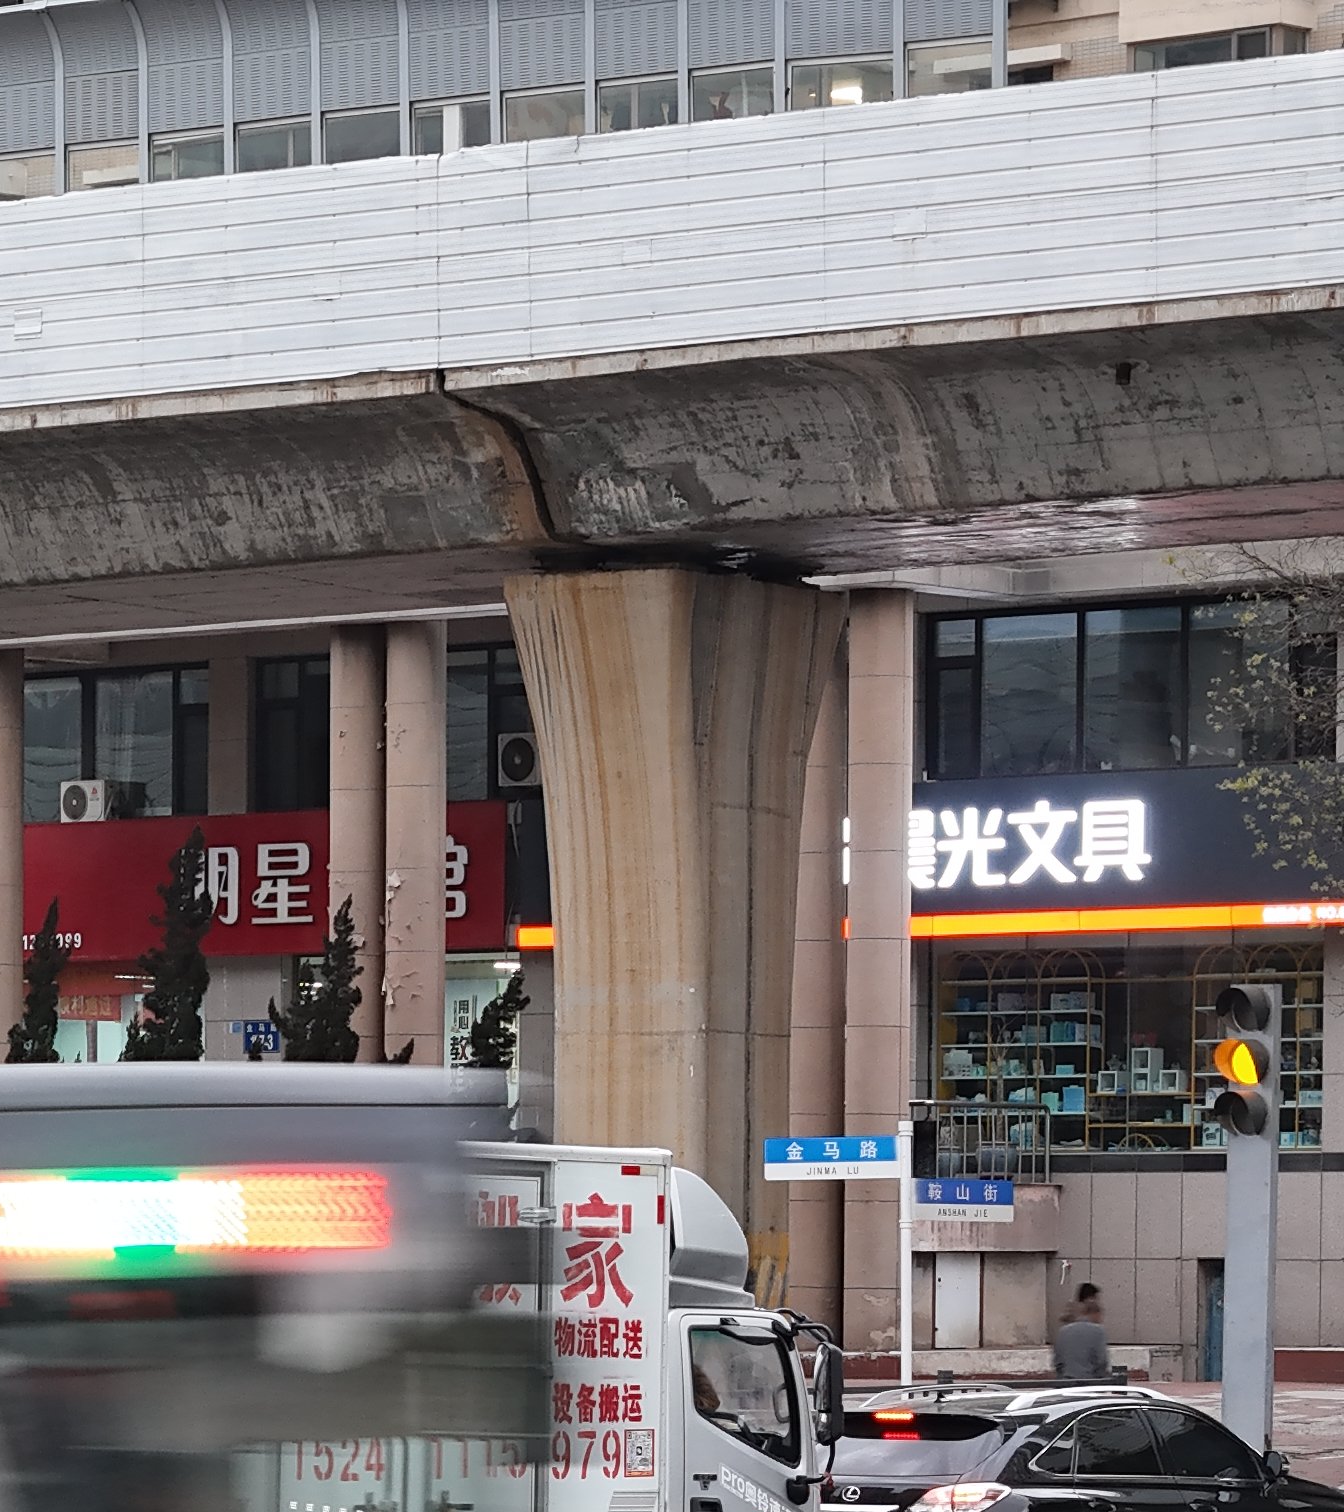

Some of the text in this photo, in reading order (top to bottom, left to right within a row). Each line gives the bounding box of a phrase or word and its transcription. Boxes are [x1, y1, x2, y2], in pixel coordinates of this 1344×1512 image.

[785, 1141, 879, 1161] 金马路
[806, 1166, 860, 1176] JINMA LU
[927, 1183, 998, 1202] 鞍山街
[937, 1208, 989, 1218] ANSHAN JIE
[554, 1317, 643, 1359] 物流配送
[552, 1383, 643, 1424] 设备搬运
